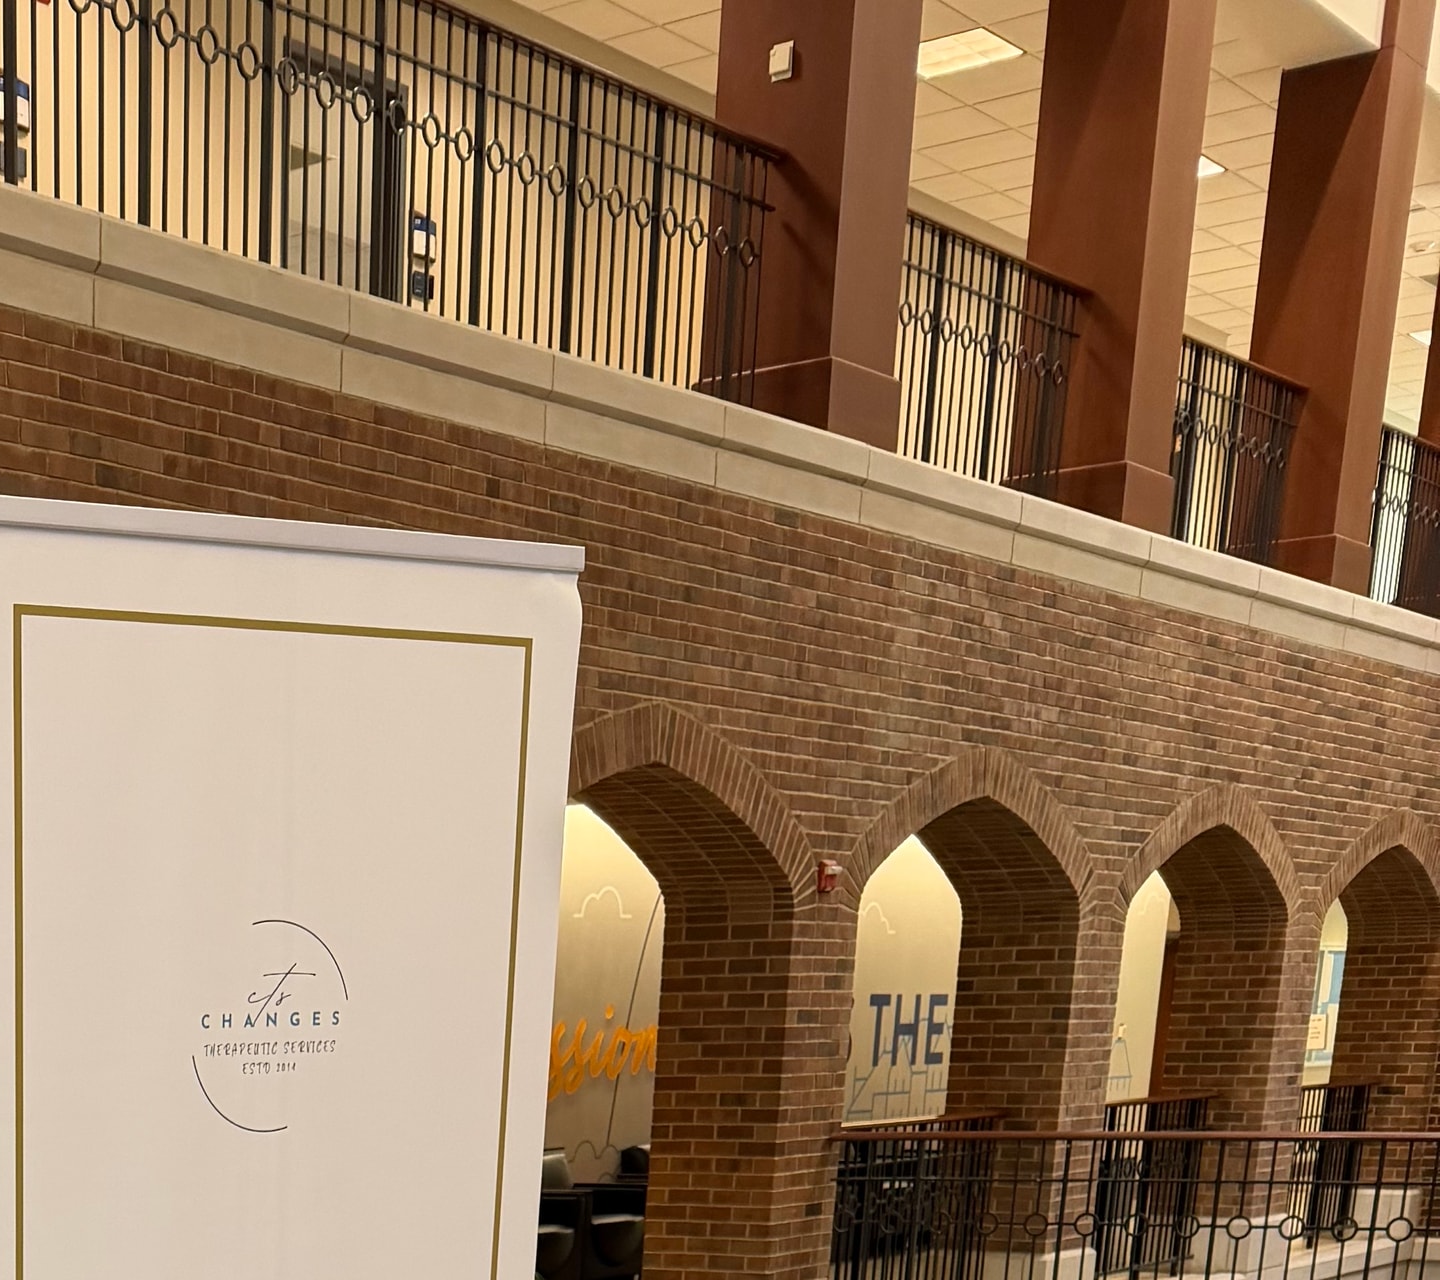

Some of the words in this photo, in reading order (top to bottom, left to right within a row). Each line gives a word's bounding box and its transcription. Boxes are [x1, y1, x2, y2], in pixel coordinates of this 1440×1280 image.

[201, 1011, 340, 1029] CHANGES
[870, 994, 948, 1067] THE
[204, 1041, 278, 1057] THERAPEUTIC
[284, 1039, 336, 1054] SERVICES
